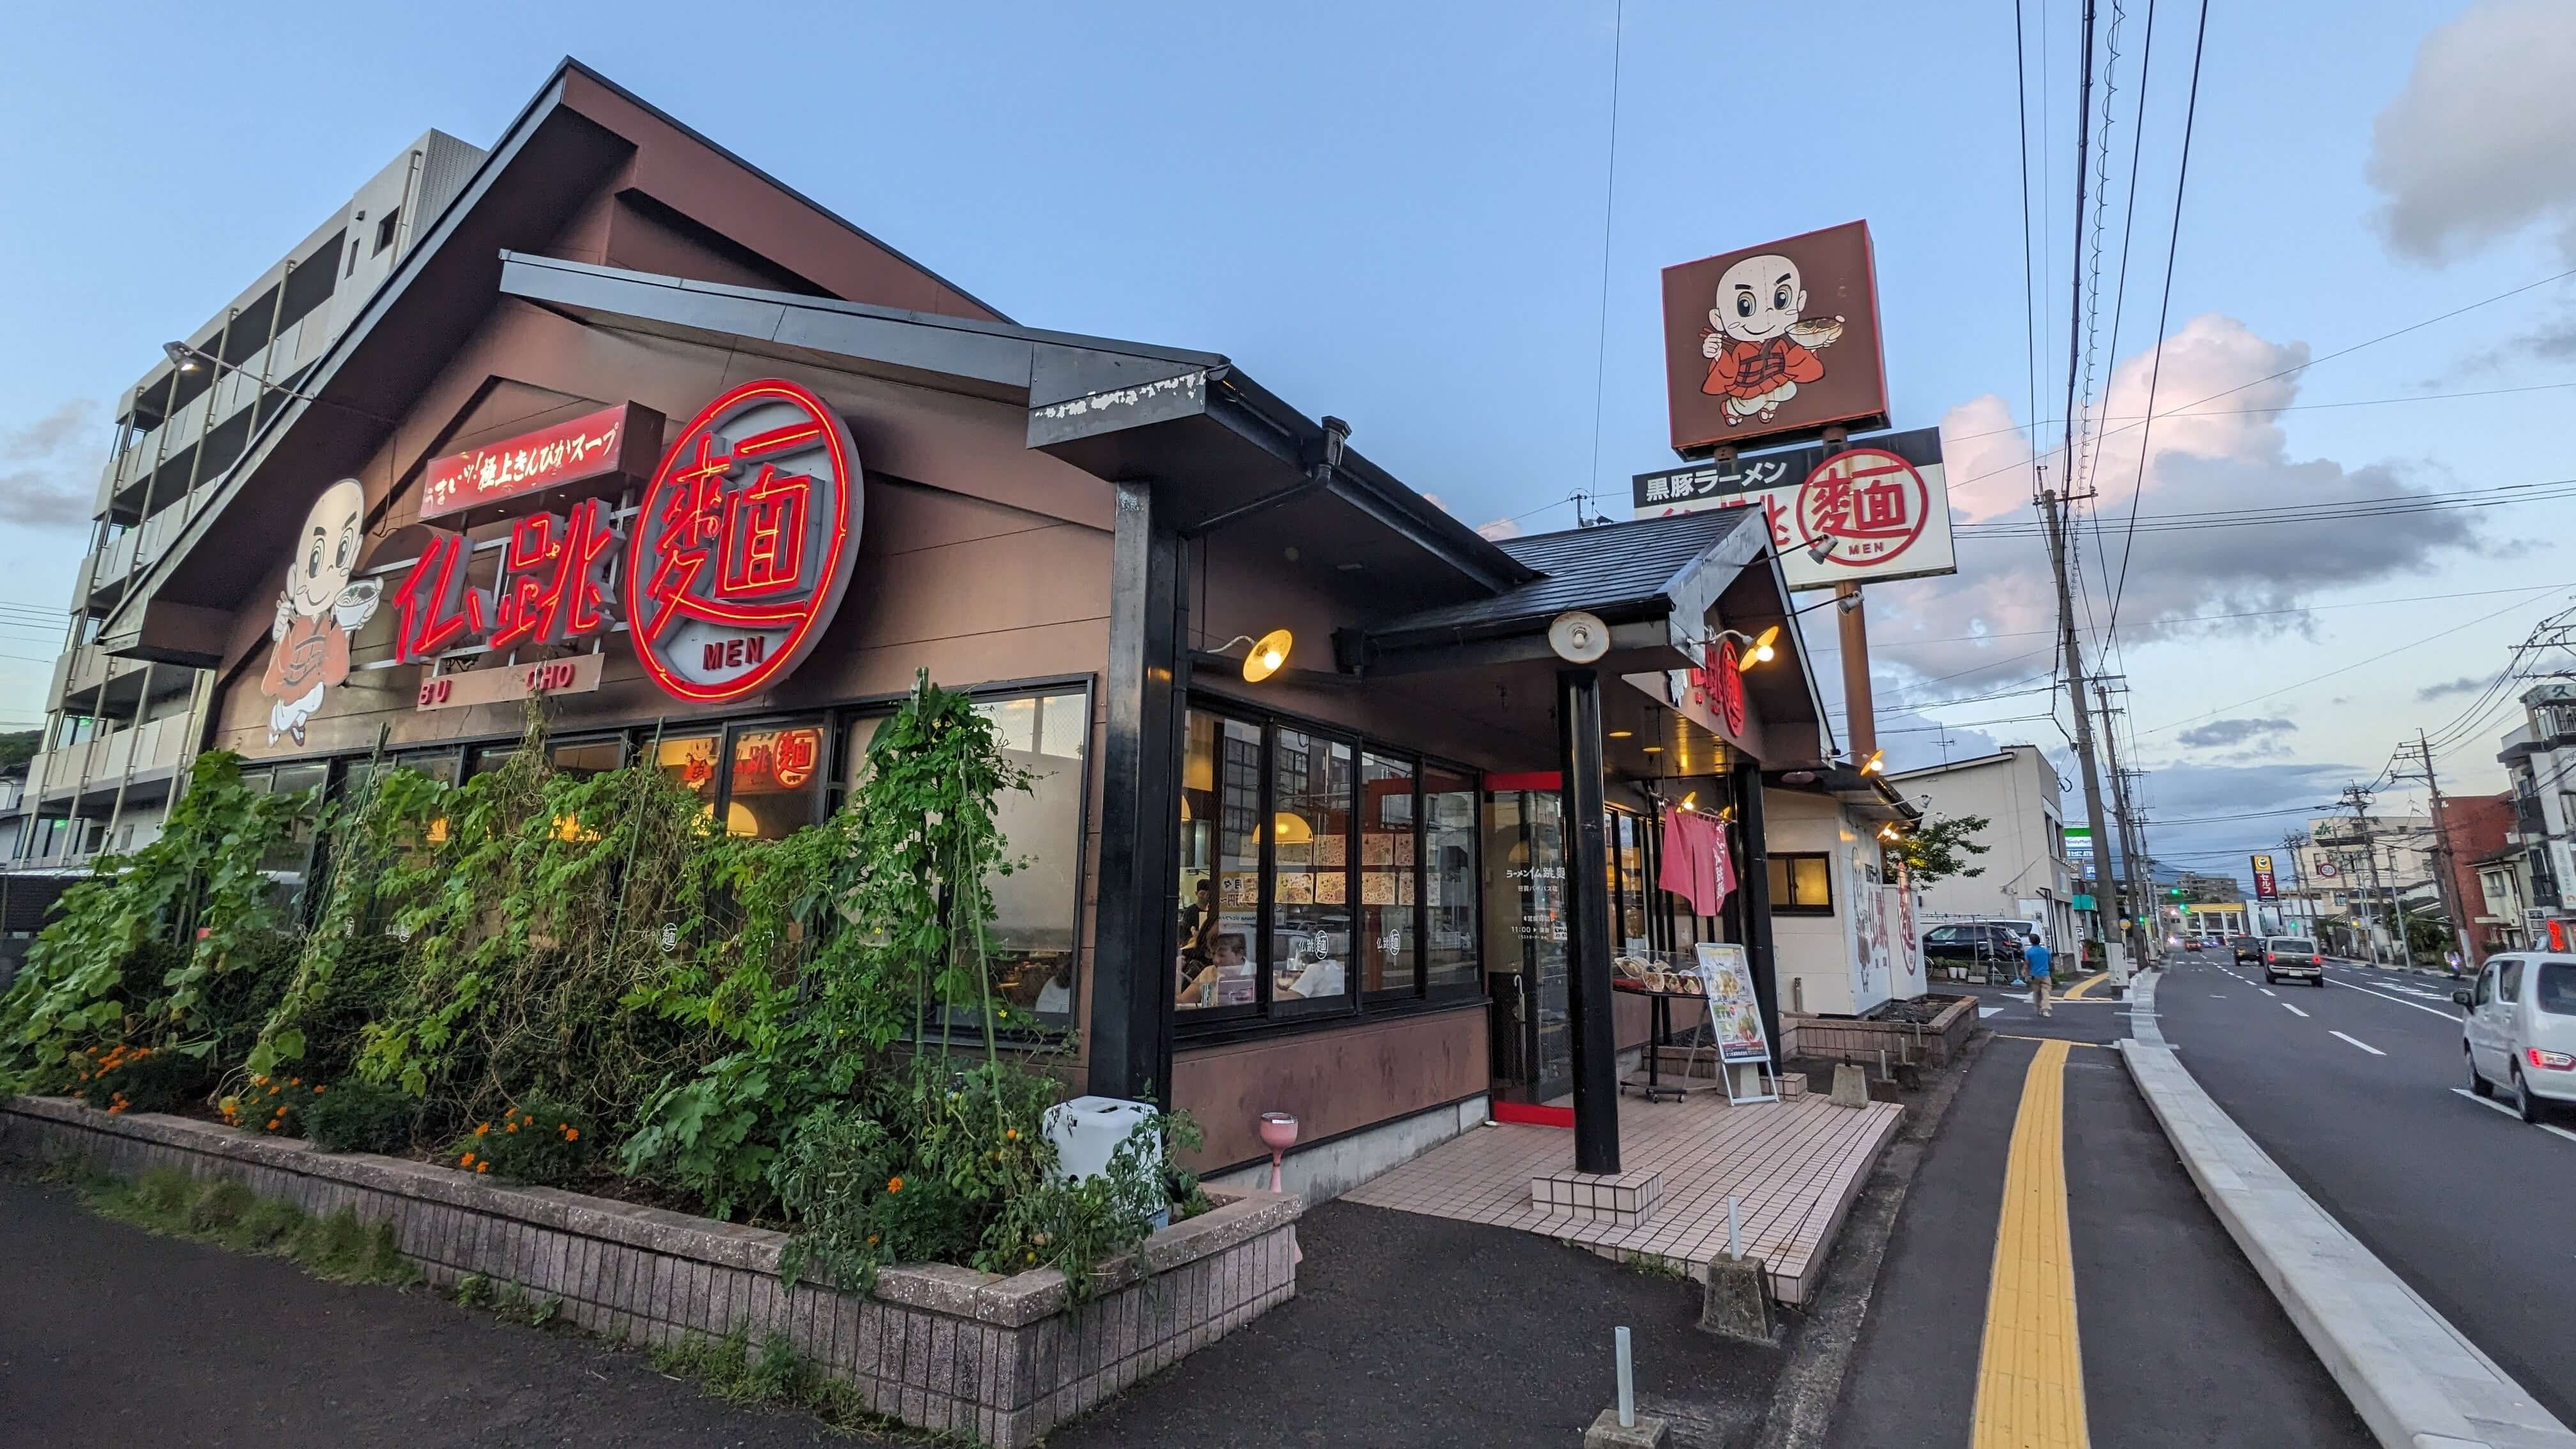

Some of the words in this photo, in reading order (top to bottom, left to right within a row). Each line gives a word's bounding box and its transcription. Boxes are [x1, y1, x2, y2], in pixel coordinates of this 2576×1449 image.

[1646, 462, 1788, 502] 黒豚ラーメン
[1848, 542, 1885, 555] MEN
[702, 636, 764, 670] MEN
[418, 680, 451, 705] BU
[526, 663, 575, 691] CHO
[2260, 873, 2272, 894] セルフ
